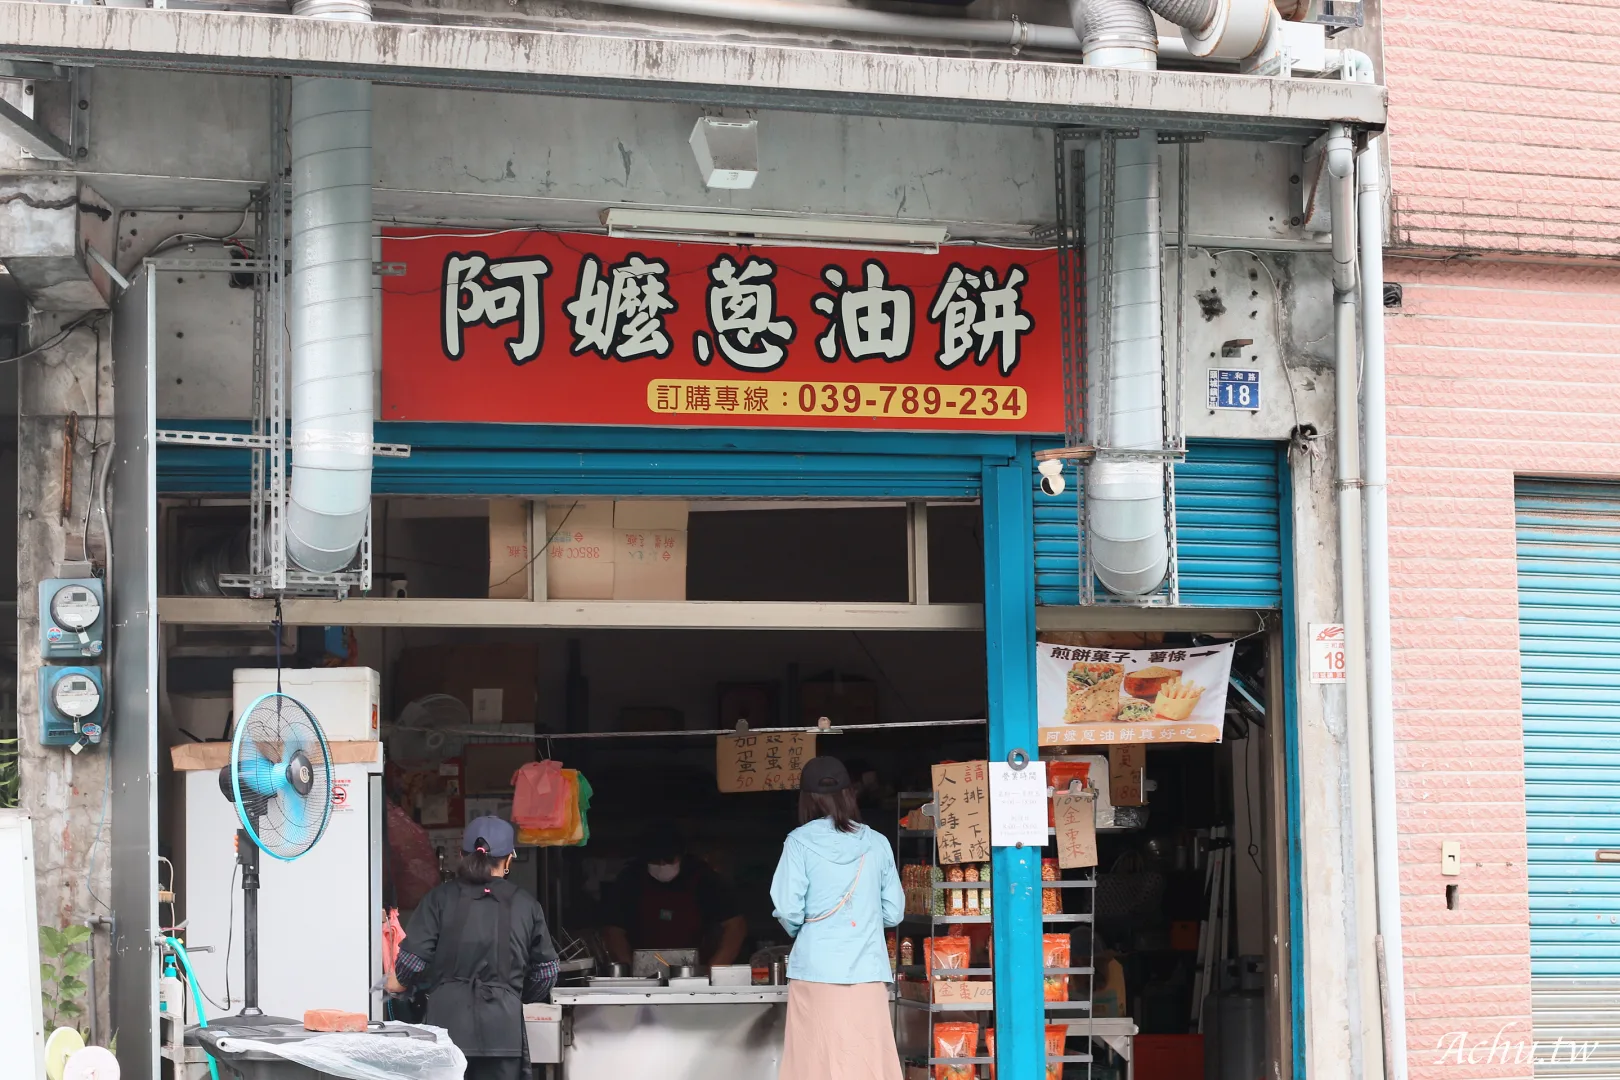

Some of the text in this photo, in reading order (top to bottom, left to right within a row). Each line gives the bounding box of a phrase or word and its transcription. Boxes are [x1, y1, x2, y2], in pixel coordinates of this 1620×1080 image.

[442, 251, 1034, 376] 阿嬤蔥油餅
[1221, 372, 1256, 381] 三和路
[798, 383, 1021, 416] 039-789-234
[1226, 384, 1250, 405] 18
[566, 545, 600, 559] 385CC
[1324, 651, 1345, 670] 18
